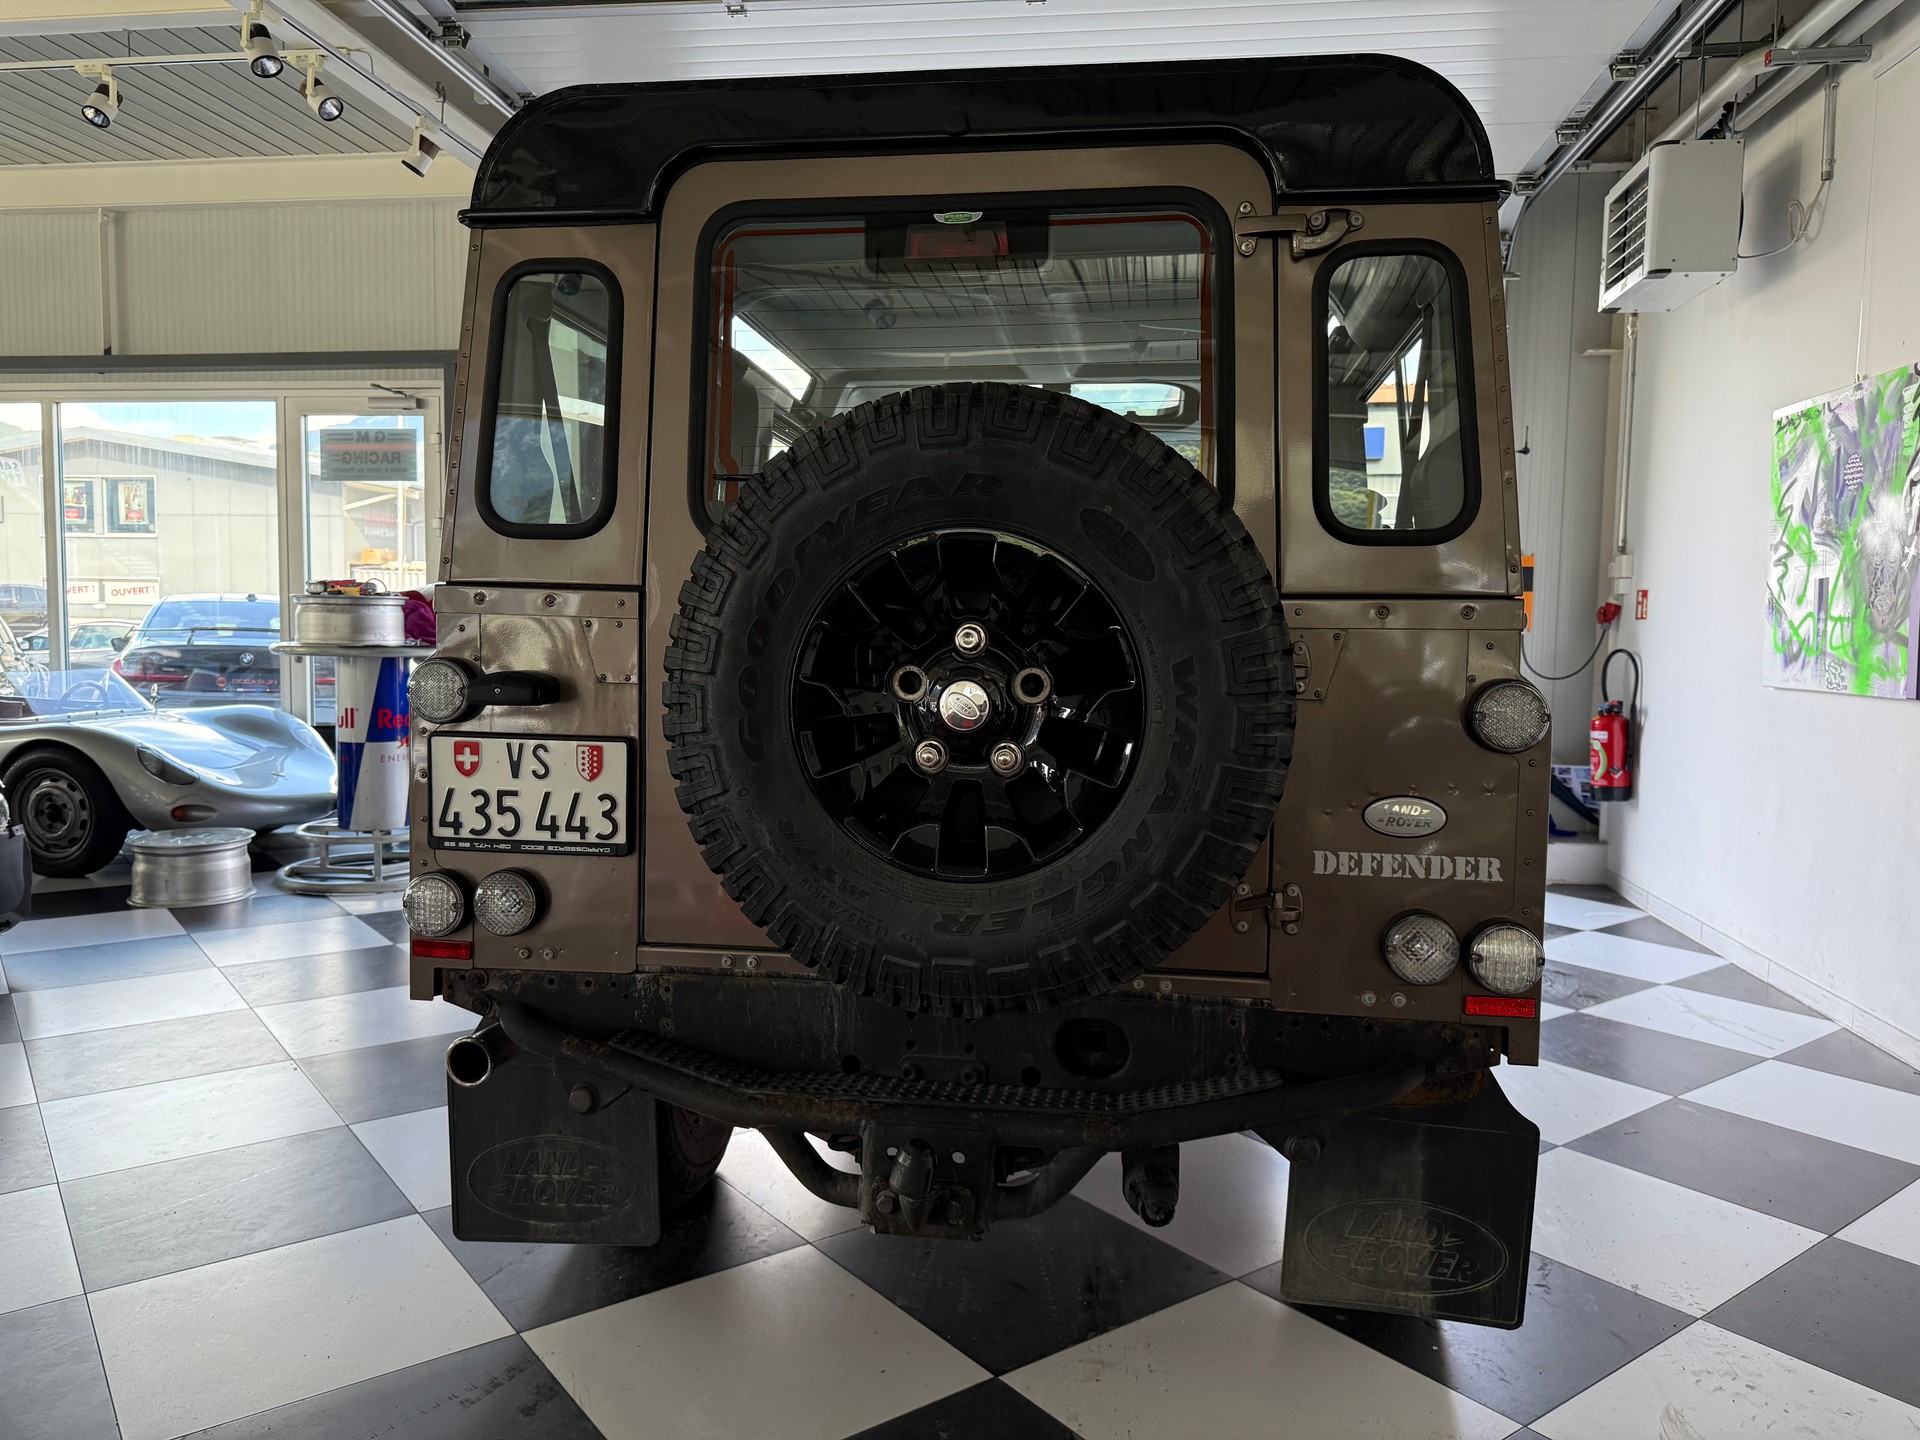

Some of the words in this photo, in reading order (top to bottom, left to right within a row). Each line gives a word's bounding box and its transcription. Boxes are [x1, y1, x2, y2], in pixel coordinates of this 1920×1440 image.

[111, 586, 149, 597] OUVERT
[506, 742, 550, 779] VS
[933, 654, 1198, 936] WRANGLER
[1383, 804, 1422, 816] LAND
[439, 788, 521, 837] 435
[535, 791, 619, 840] 443
[1385, 815, 1432, 828] ROVER
[1313, 850, 1503, 882] DEFENDER
[500, 1150, 586, 1177] LAND
[510, 1179, 617, 1208] ROVER
[1345, 1211, 1445, 1247] LAND
[1351, 1240, 1480, 1283] ROVER
